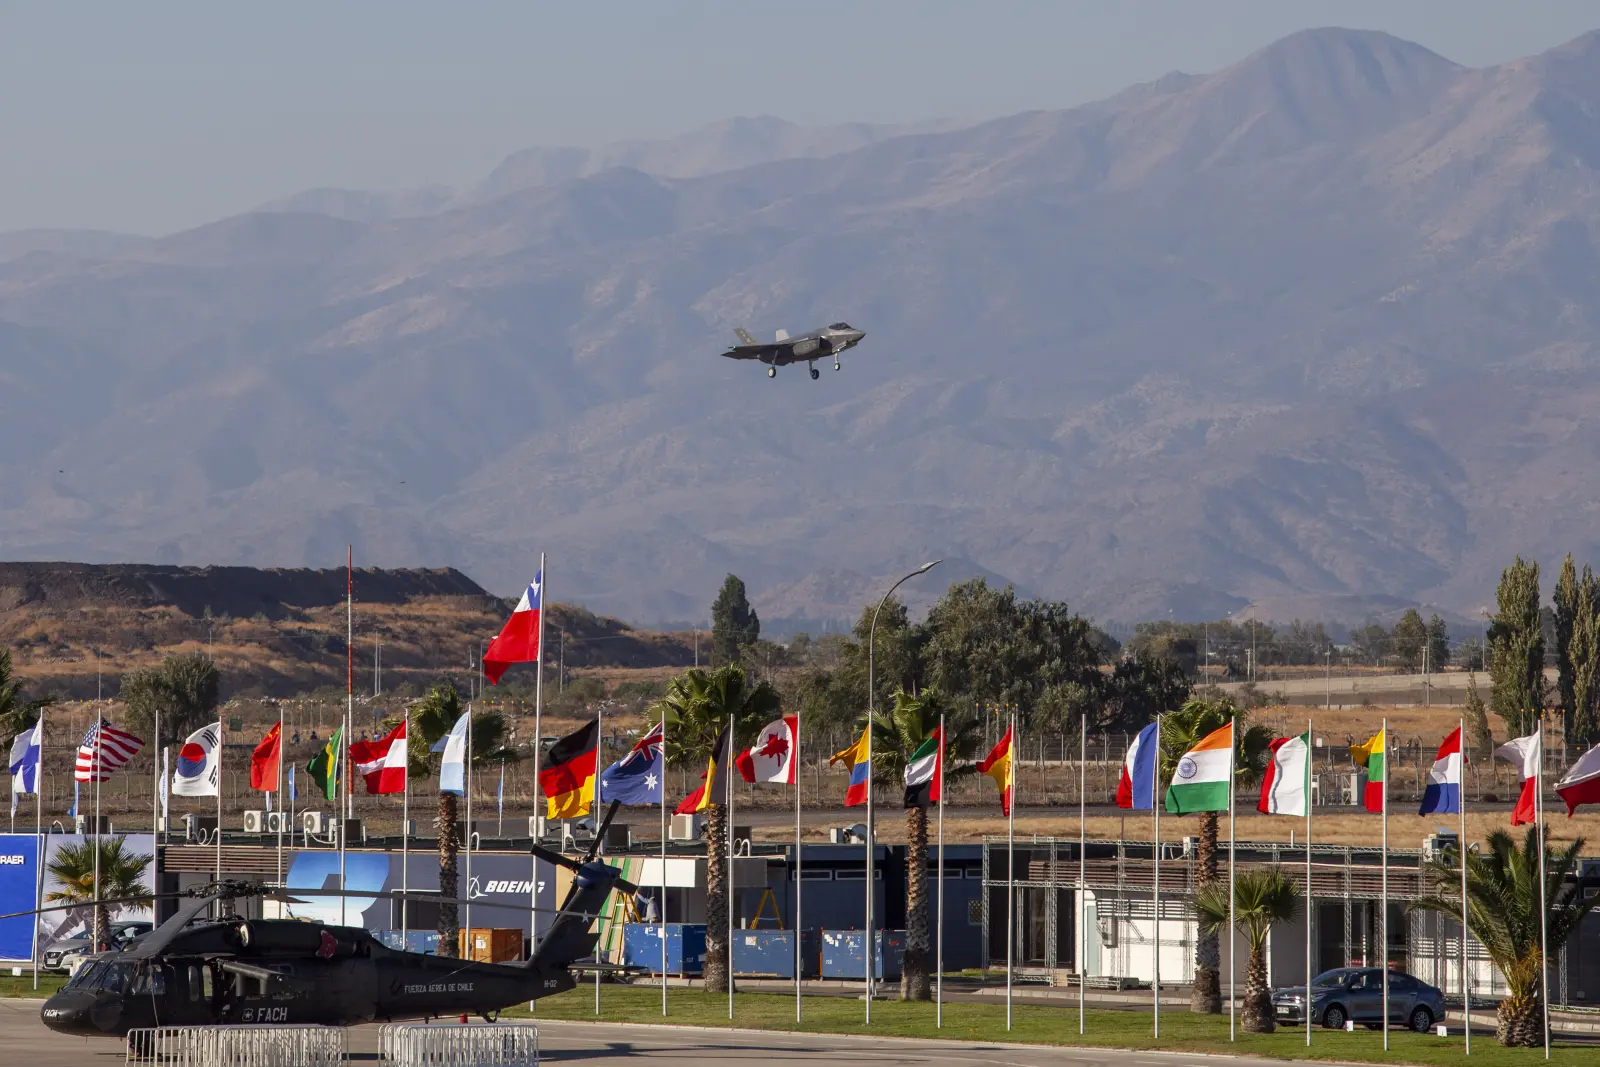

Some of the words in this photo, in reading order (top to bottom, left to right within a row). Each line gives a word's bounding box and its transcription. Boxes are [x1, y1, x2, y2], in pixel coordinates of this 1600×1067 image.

[0, 855, 24, 865] RAER
[404, 985, 427, 994] FUERZA
[428, 984, 447, 993] AEREA
[448, 983, 456, 992] DE
[457, 982, 475, 992] CHILE
[256, 1006, 288, 1022] FACH
